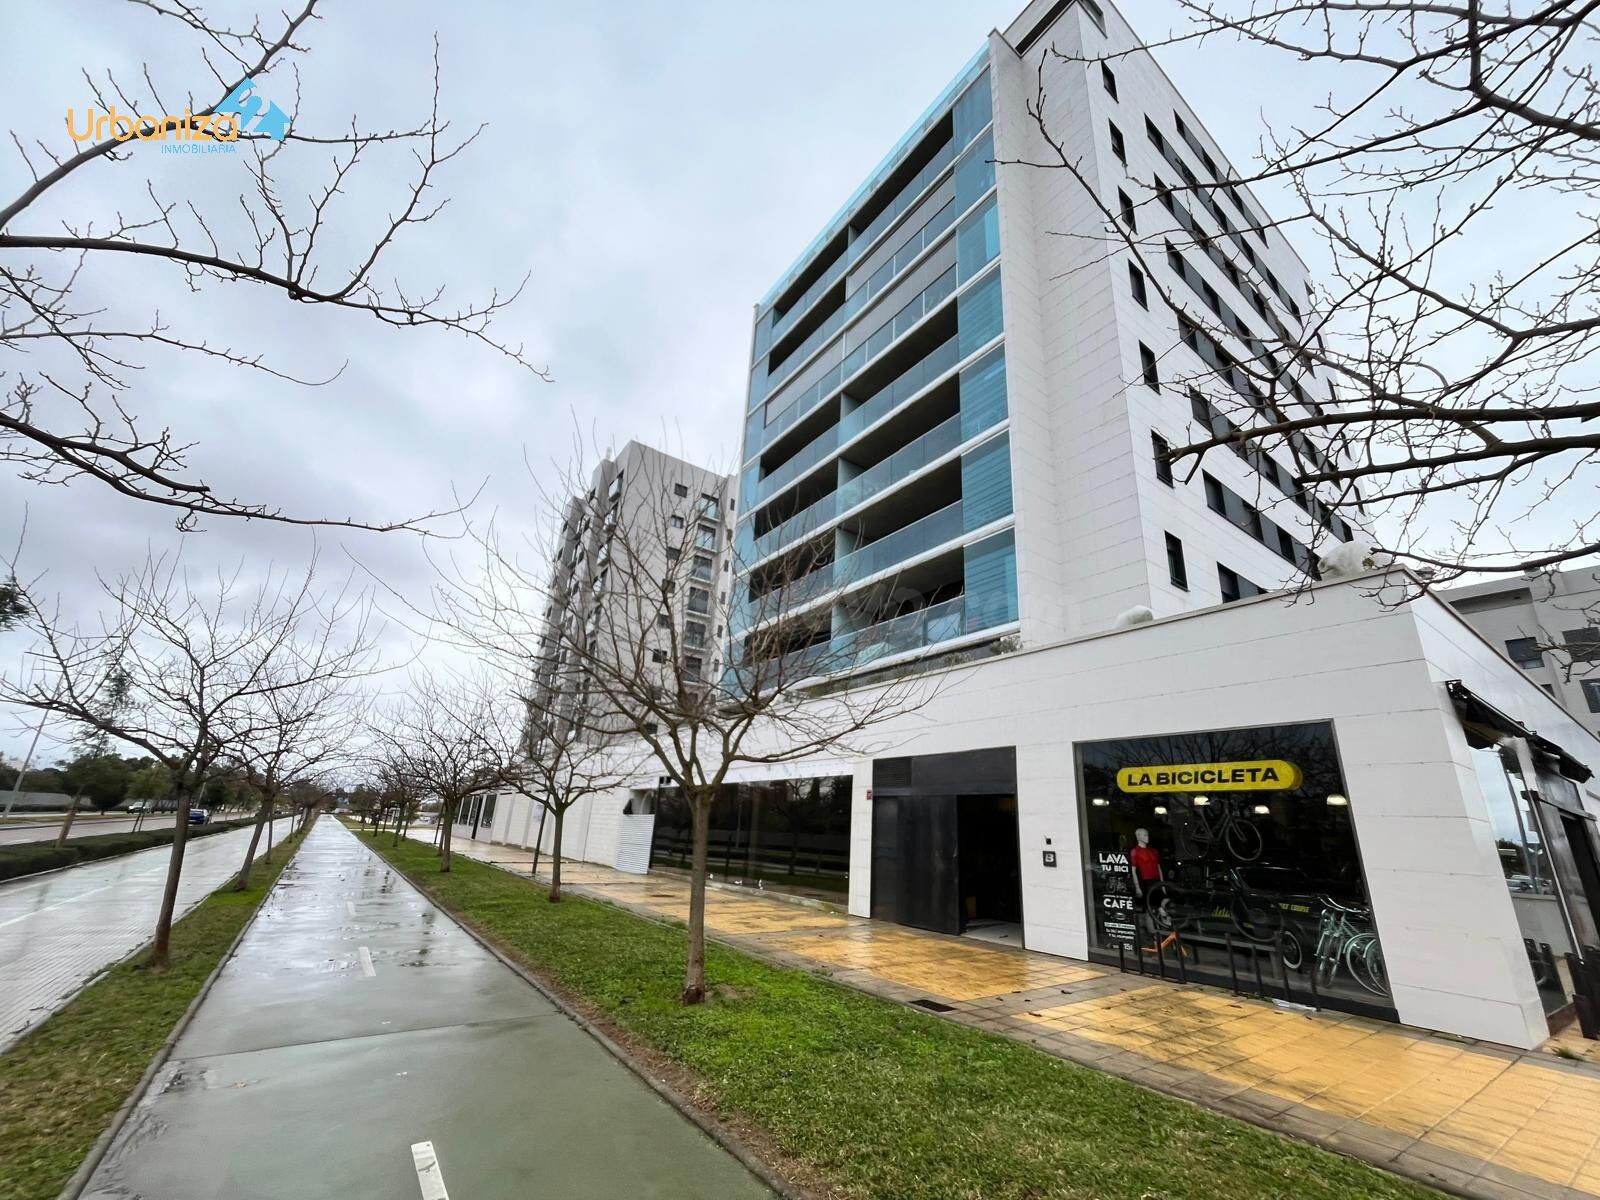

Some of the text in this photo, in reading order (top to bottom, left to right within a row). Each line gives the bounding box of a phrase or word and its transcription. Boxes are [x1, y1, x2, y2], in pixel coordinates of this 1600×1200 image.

[1127, 767, 1280, 787] LA BICICLETA
[1098, 852, 1129, 865] LAVA
[1101, 864, 1129, 873] TU BICI
[1103, 897, 1134, 910] CAFÉ
